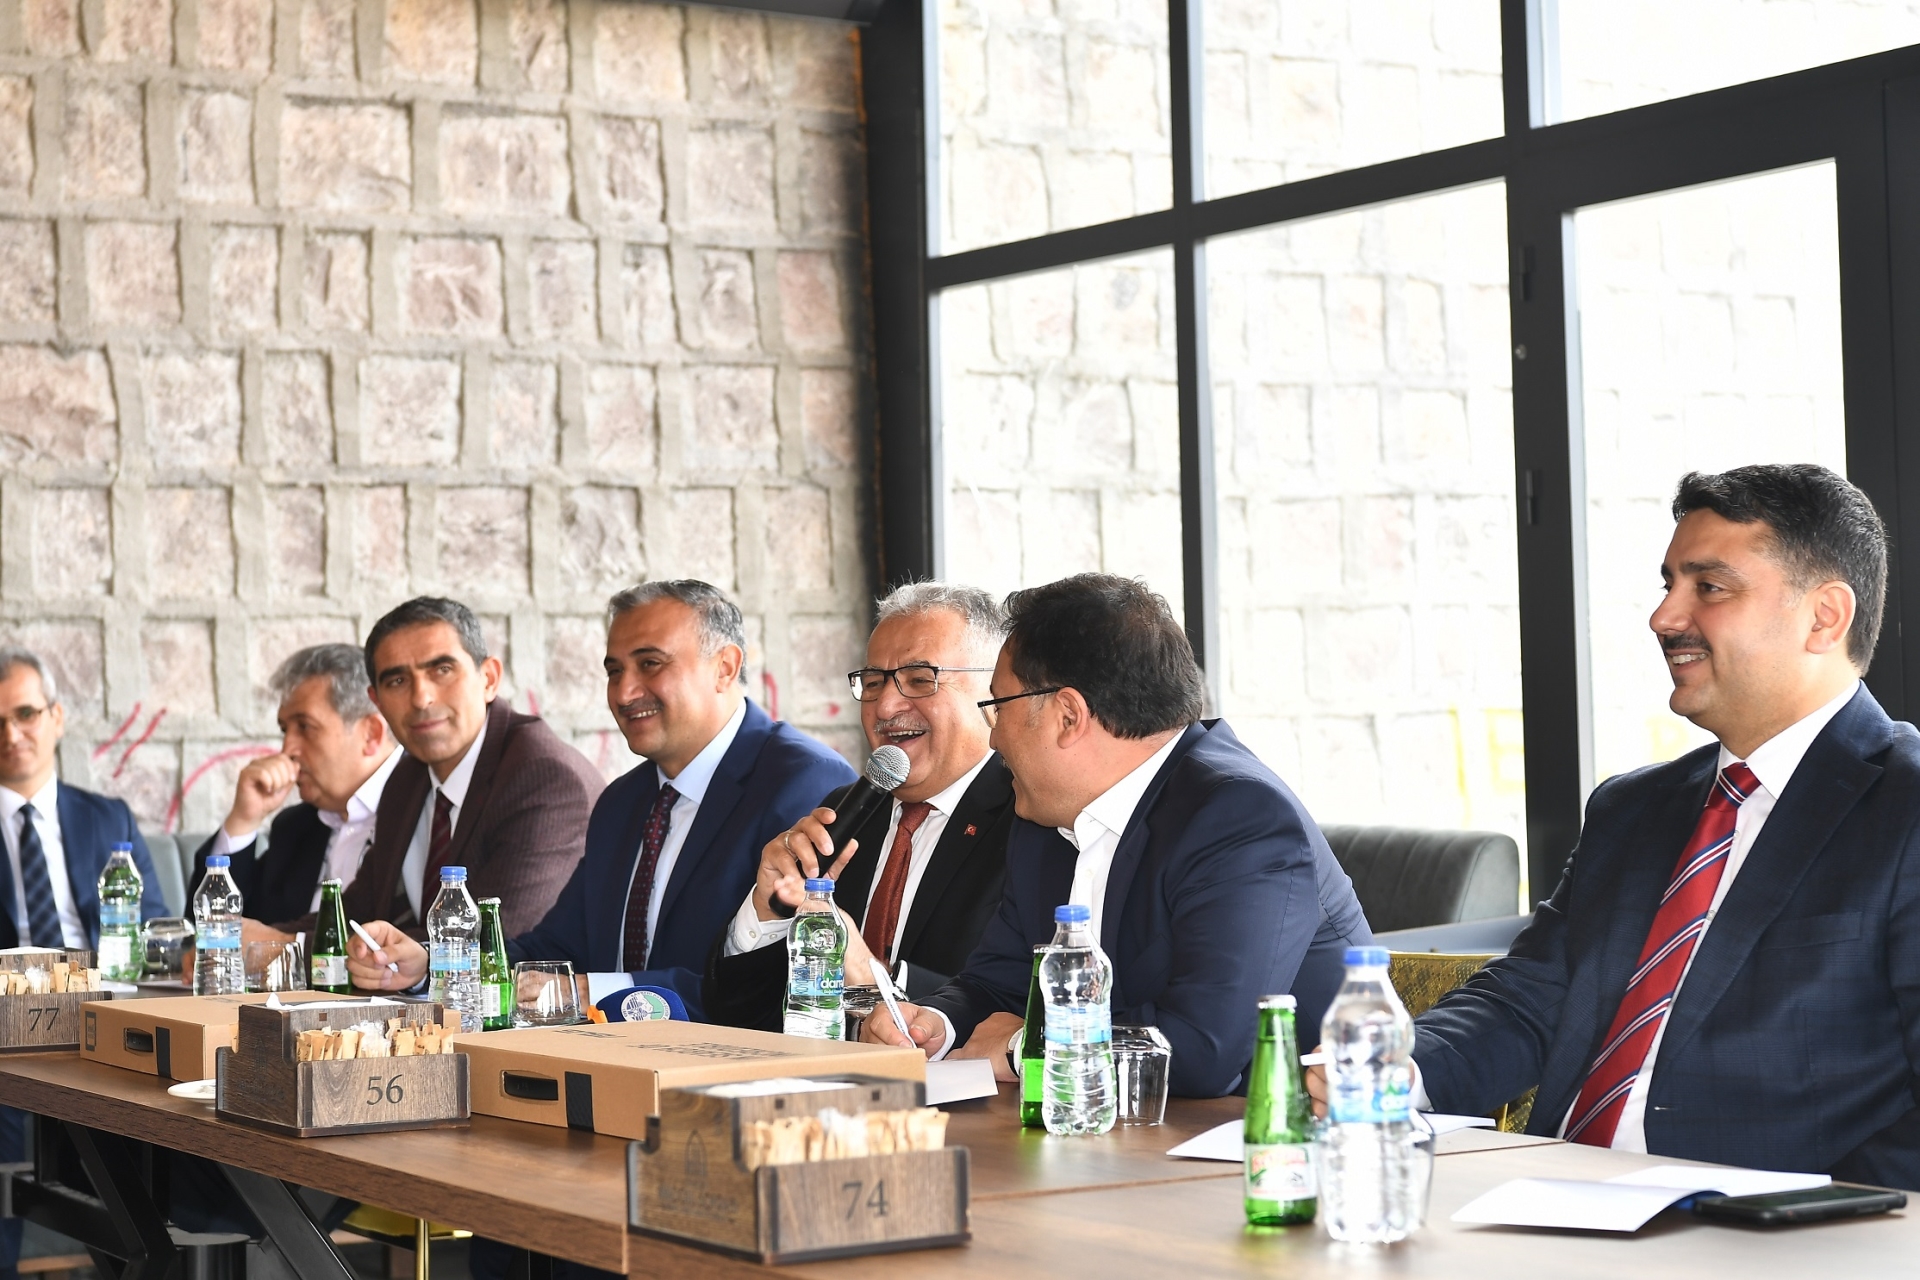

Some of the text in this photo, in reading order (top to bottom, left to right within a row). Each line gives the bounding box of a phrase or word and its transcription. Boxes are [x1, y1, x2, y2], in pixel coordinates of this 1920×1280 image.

[28, 1007, 60, 1032] 77
[366, 1073, 404, 1106] 56
[841, 1178, 889, 1221] 74
